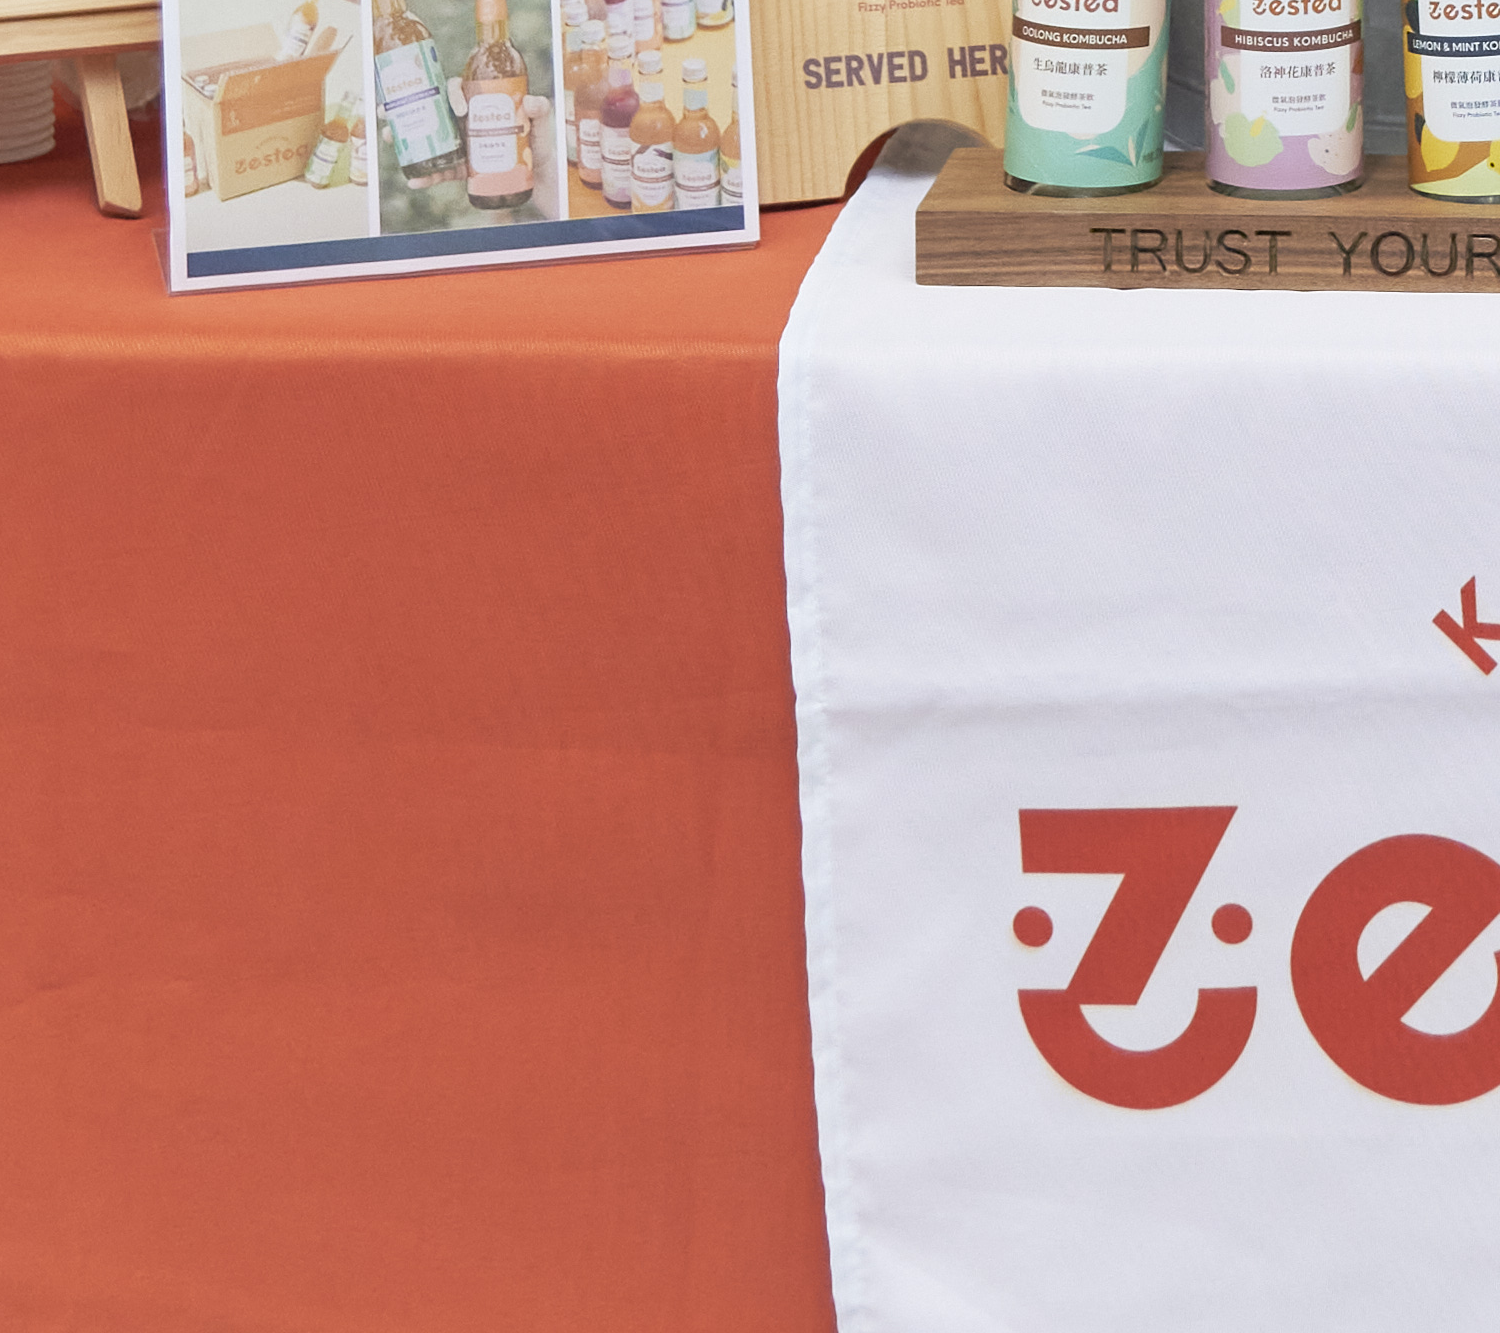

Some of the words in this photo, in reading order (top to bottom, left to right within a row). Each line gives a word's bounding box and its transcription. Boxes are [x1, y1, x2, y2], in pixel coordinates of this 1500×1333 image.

[858, 2, 886, 14] Fizzy
[1022, 25, 1060, 42] OOLONG
[1063, 33, 1127, 45] KOMBUCHA
[1235, 34, 1289, 47] HIBISCUS
[1293, 29, 1353, 47] KOMBUCHA
[1413, 38, 1440, 51] LEMON
[1443, 43, 1450, 52] &
[1453, 41, 1480, 52] MINT
[803, 49, 928, 90] SERVED
[947, 43, 1009, 79] HER
[1260, 62, 1336, 79] 洛神花康普茶
[1089, 226, 1291, 276] TRUST
